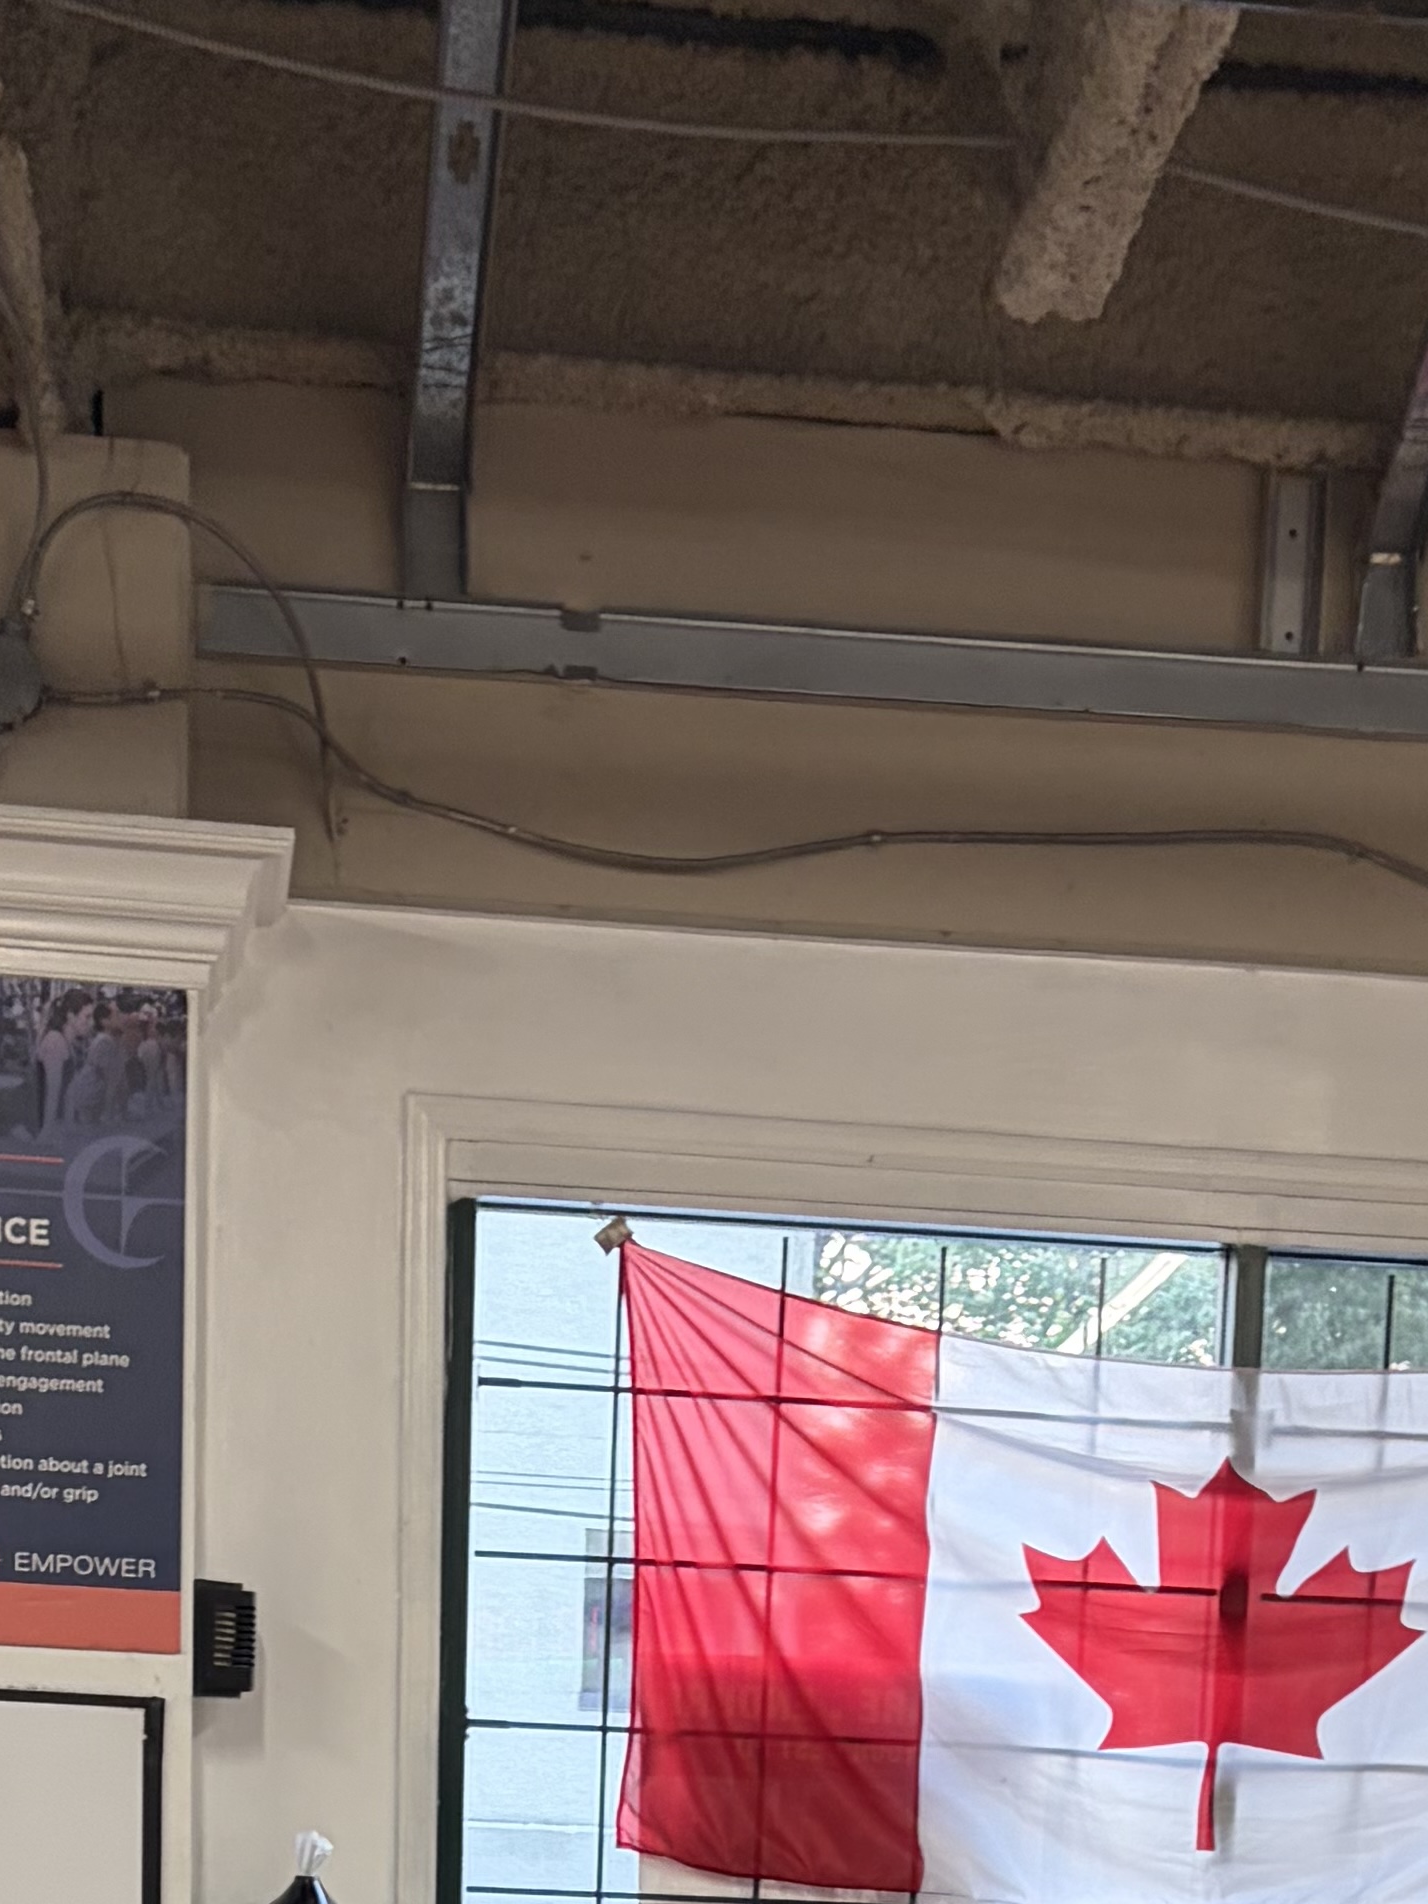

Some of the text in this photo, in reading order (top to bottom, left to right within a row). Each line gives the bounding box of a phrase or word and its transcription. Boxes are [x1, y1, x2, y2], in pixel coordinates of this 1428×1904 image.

[18, 1320, 111, 1340] movement
[20, 1345, 78, 1365] frontal
[81, 1349, 131, 1368] plane
[37, 1457, 89, 1474] about
[92, 1463, 104, 1475] a
[106, 1460, 147, 1478] joint
[0, 1482, 60, 1501] and/or
[62, 1485, 99, 1504] grip
[13, 1551, 157, 1580] EMPOWER
